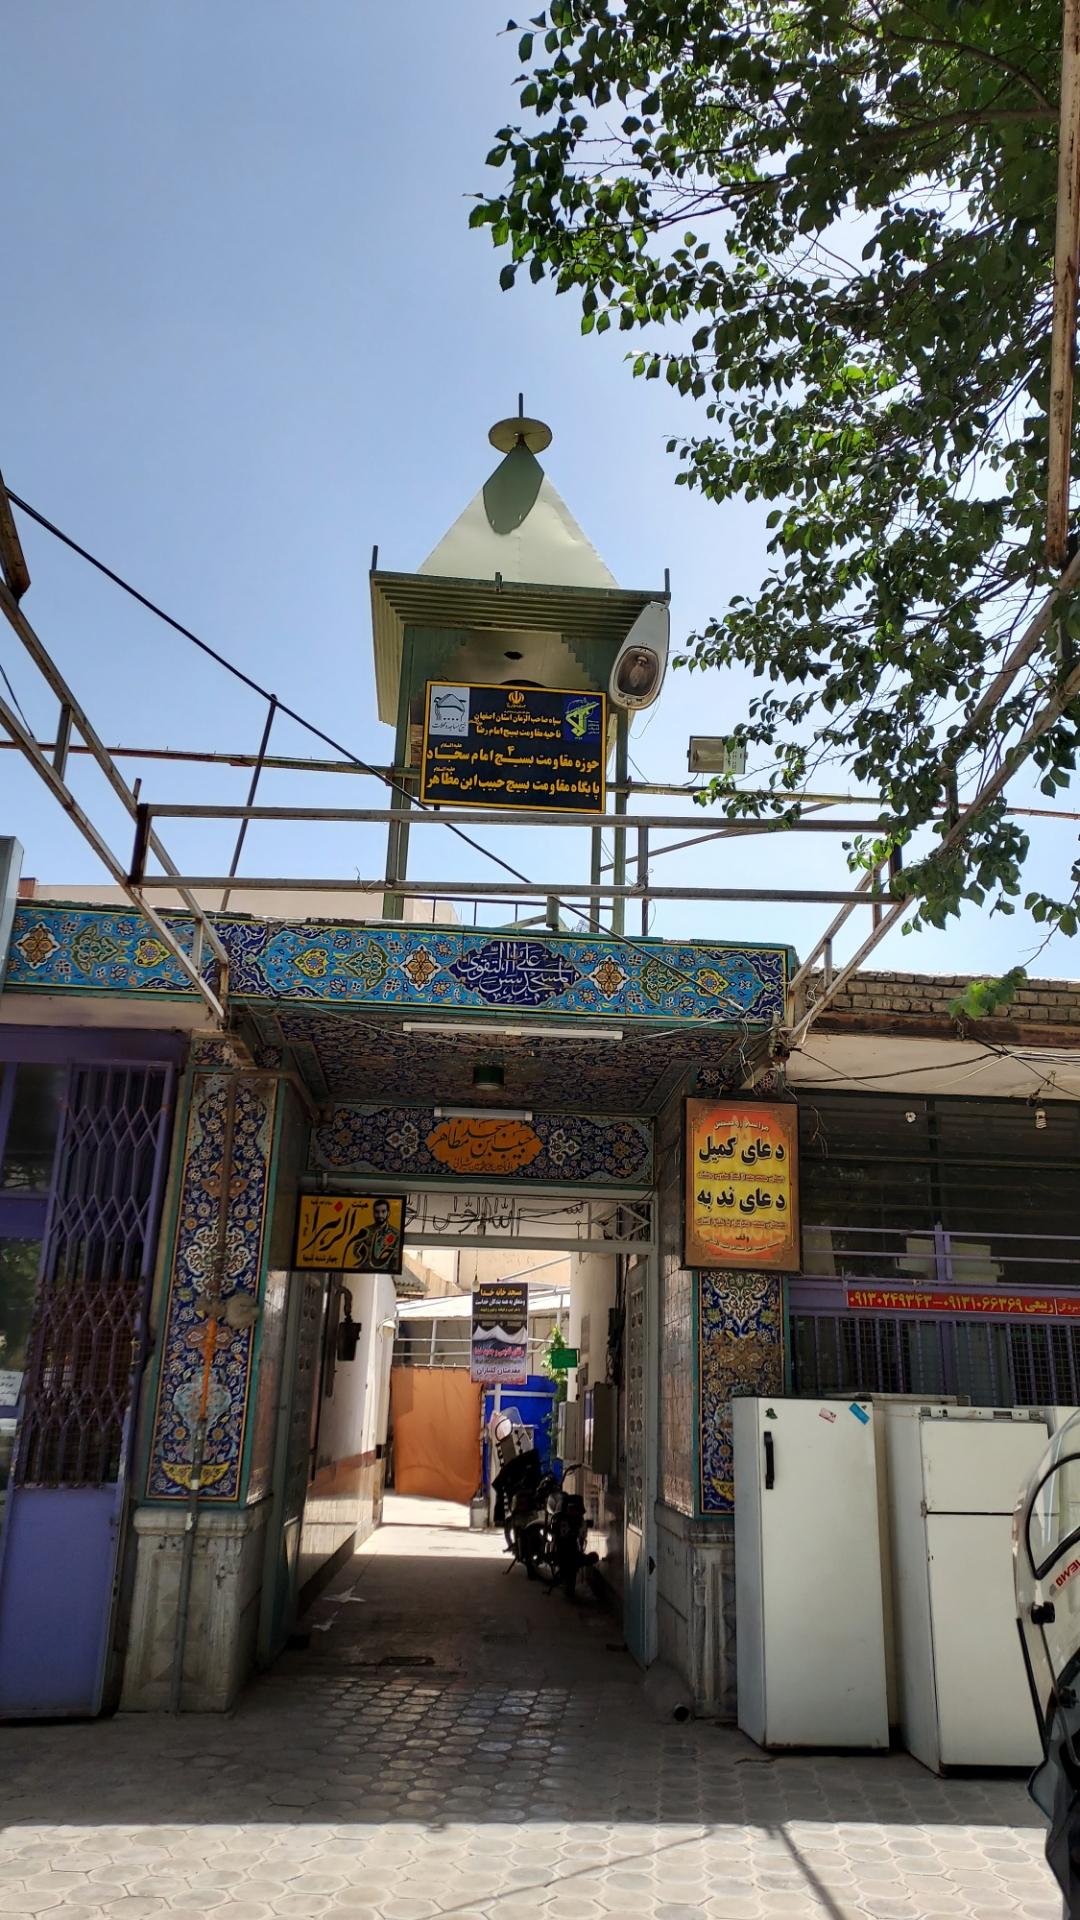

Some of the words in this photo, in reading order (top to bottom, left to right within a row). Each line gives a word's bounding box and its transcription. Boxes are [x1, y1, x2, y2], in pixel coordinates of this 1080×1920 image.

[473, 711, 495, 721] اصفهان
[495, 713, 512, 723] استان
[476, 726, 488, 736] رضا
[488, 726, 503, 736] امام
[503, 727, 518, 737] بسیج
[427, 748, 470, 761] سجاد
[471, 748, 494, 763] امام
[495, 752, 534, 767] بسیج
[536, 754, 574, 770] مقاومت
[575, 759, 599, 772] حوزه
[427, 771, 459, 789] مظاهر
[460, 774, 478, 790] ابن
[478, 778, 505, 792] حبیب
[506, 778, 530, 793] بسیج
[533, 777, 570, 795] مقاومت
[571, 778, 600, 800] پایگاه
[699, 1136, 738, 1163] کمیل
[741, 1137, 785, 1164] دعای
[696, 1186, 735, 1212] ندبه
[740, 1187, 786, 1213] دعای
